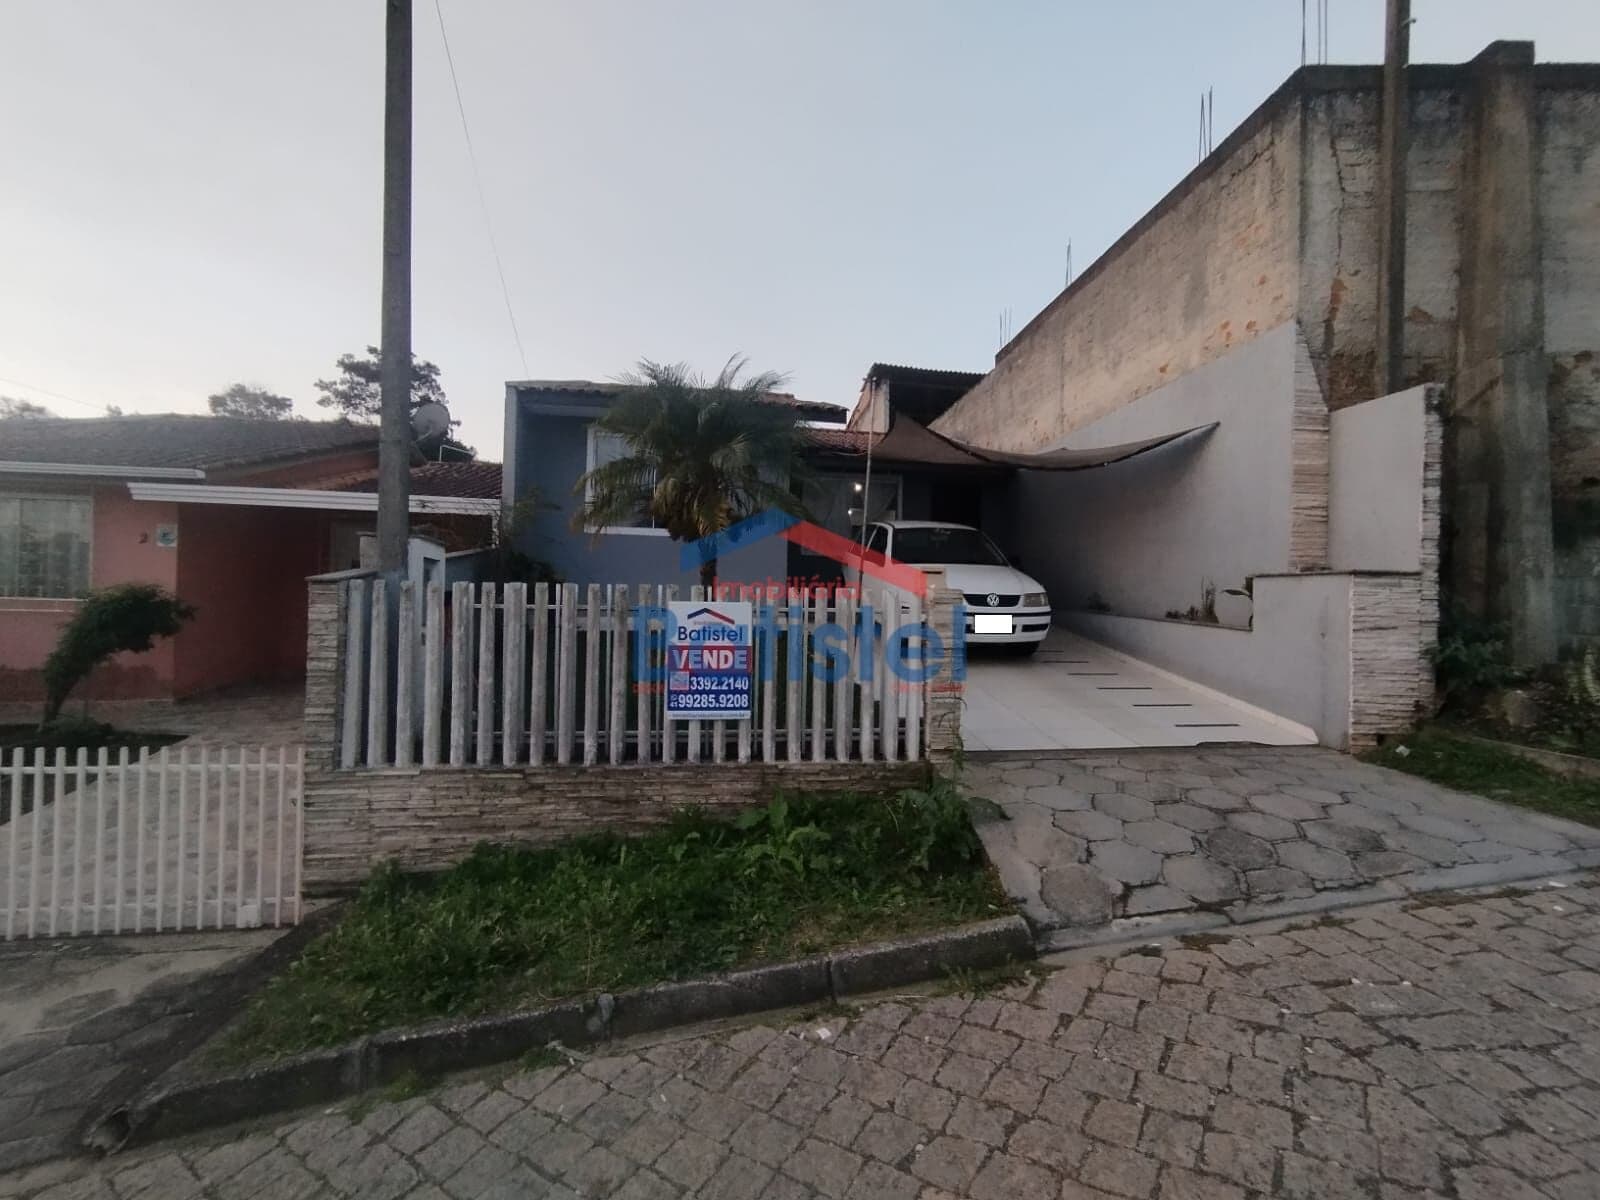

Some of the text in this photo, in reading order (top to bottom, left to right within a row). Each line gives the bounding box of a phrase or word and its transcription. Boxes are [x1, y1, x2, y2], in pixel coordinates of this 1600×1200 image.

[677, 626, 743, 641] Batistel
[672, 650, 747, 669] VENDE
[690, 677, 749, 690] 3392.2140
